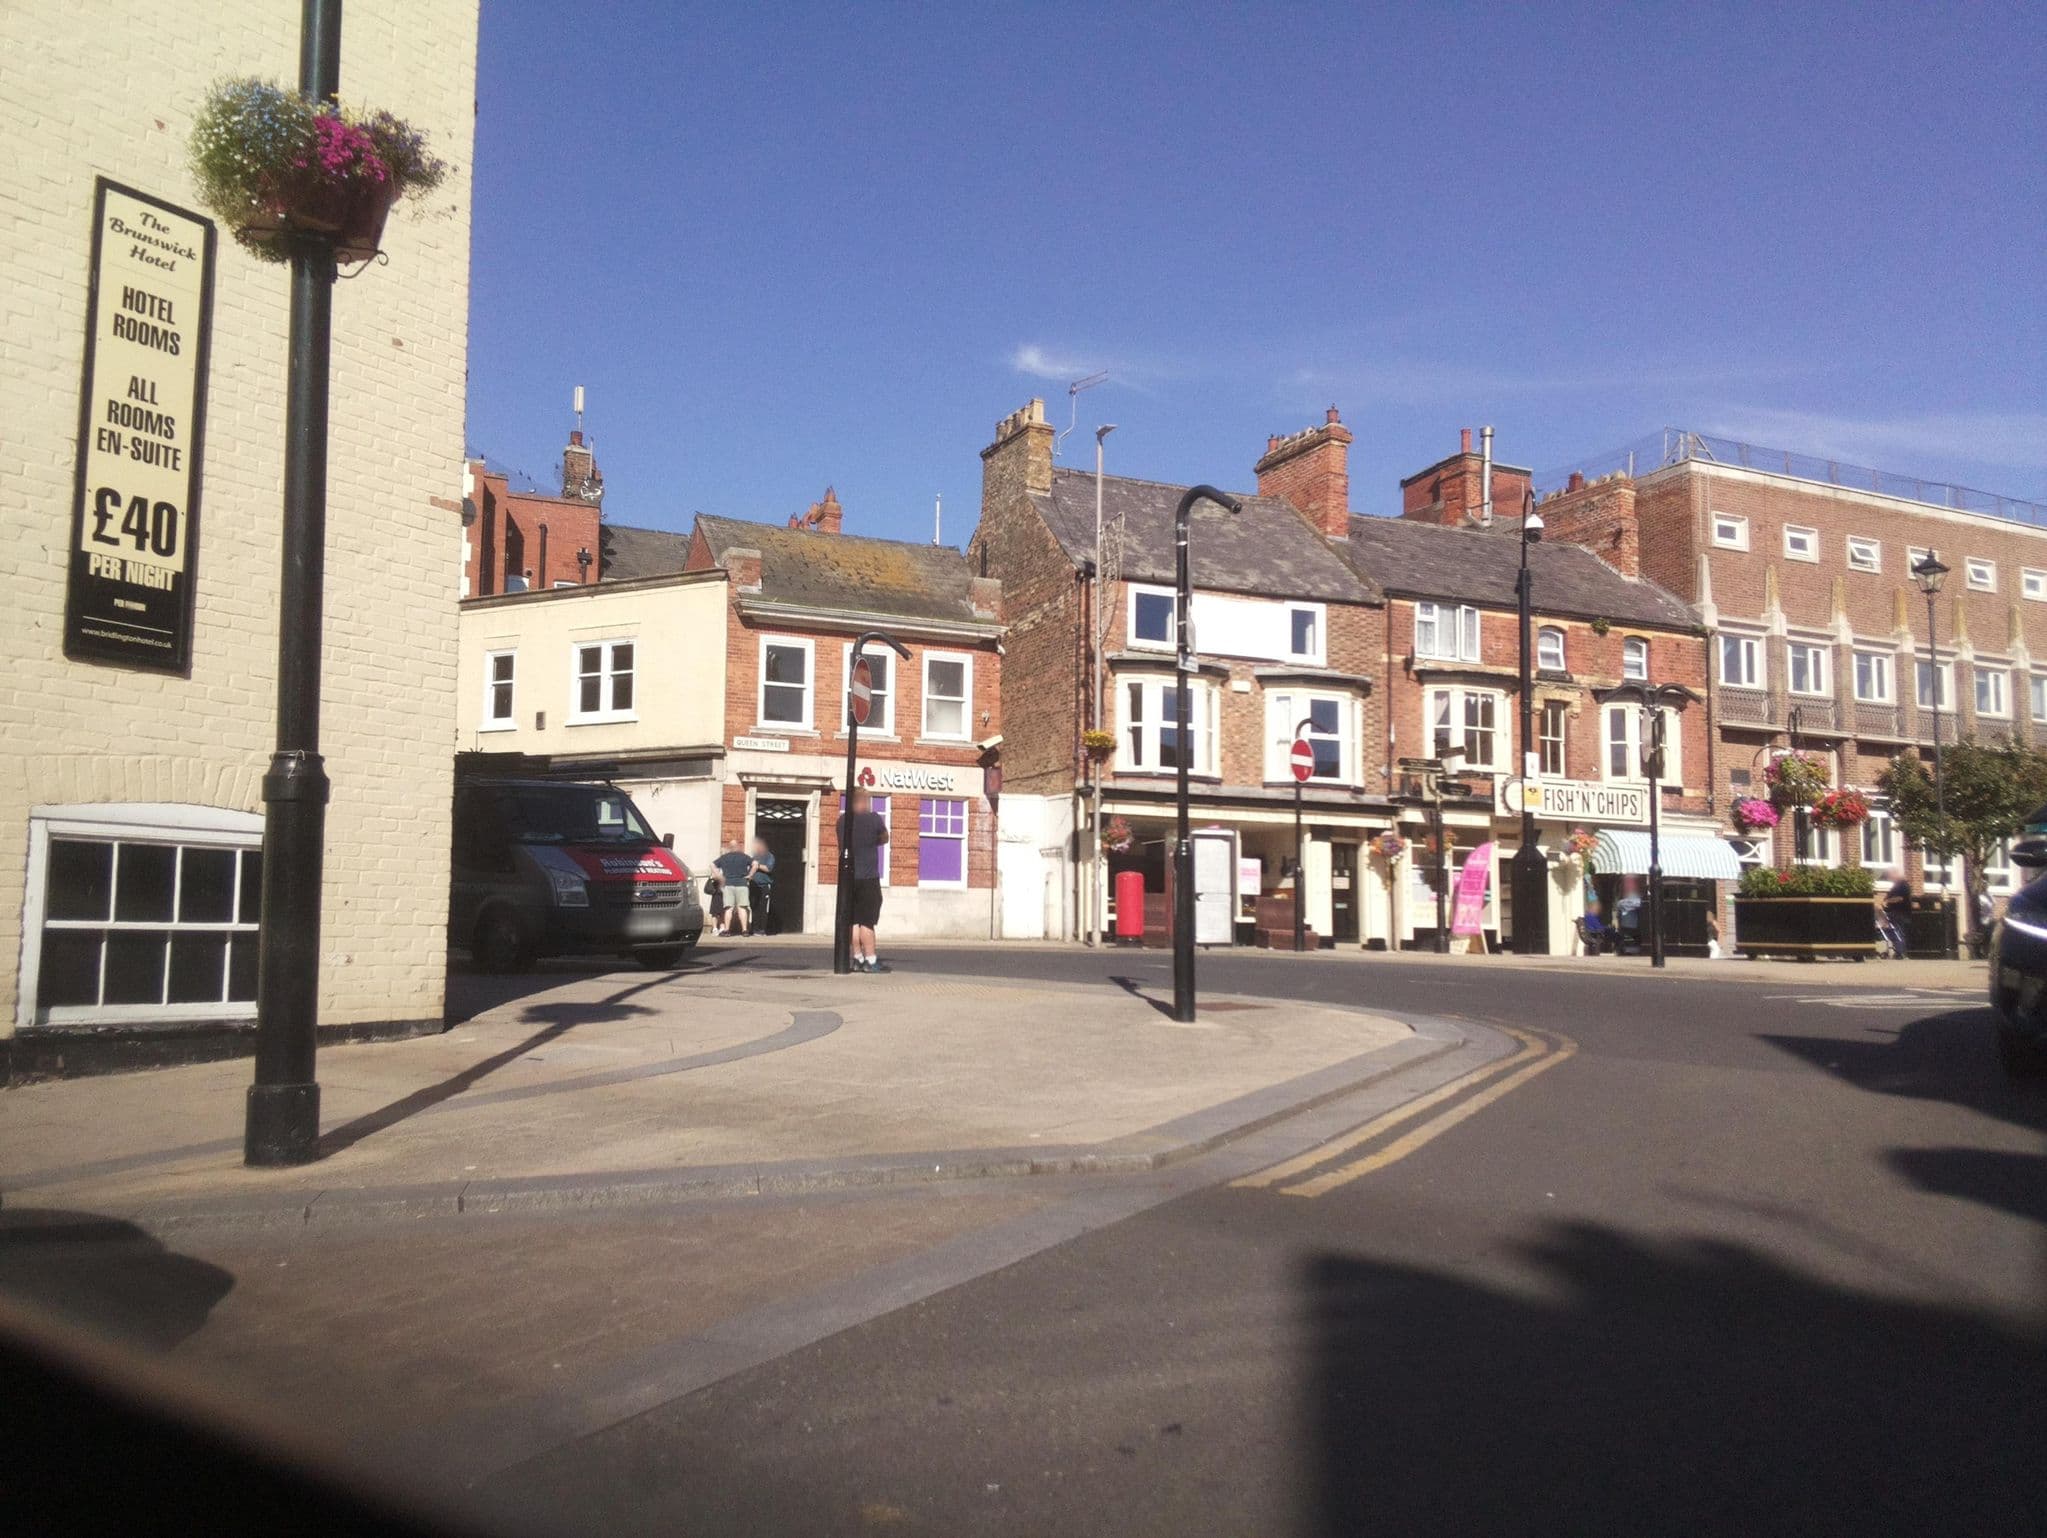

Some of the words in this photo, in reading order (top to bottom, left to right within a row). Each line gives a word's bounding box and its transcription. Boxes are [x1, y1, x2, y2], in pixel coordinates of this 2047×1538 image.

[109, 217, 197, 261] Brunswick
[140, 211, 171, 235] The
[130, 245, 177, 272] Hotel
[122, 285, 175, 325] HOTEL
[112, 313, 181, 356] ROOMS
[127, 375, 158, 406] ALL
[107, 399, 175, 440] ROOMS
[96, 427, 182, 472] EN-SUITE
[92, 487, 178, 557] £40
[89, 553, 122, 580] PER
[125, 560, 176, 592] NIGHT
[880, 767, 954, 791] NatWest
